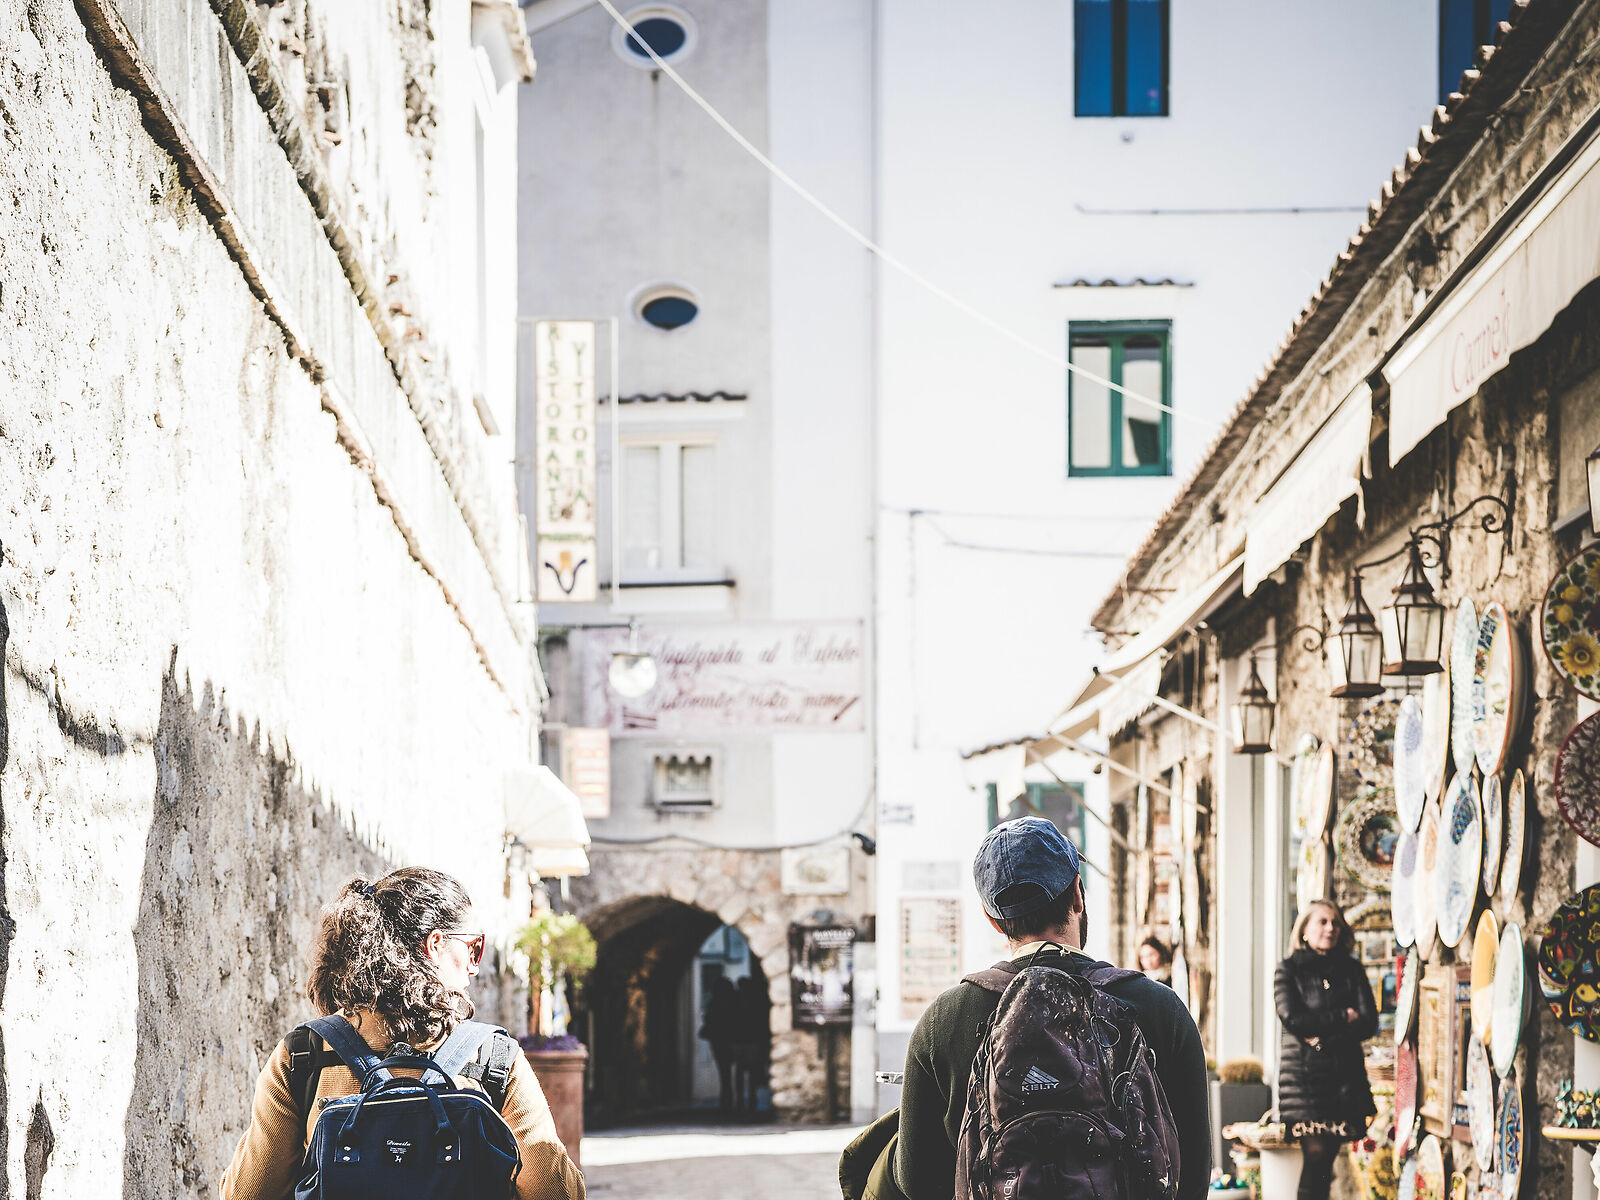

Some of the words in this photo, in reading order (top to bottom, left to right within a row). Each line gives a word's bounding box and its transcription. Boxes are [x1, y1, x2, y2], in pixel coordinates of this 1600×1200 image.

[547, 324, 561, 523] RISTORANTE
[572, 341, 588, 503] VITTORIA
[1021, 1082, 1060, 1092] KELTY
